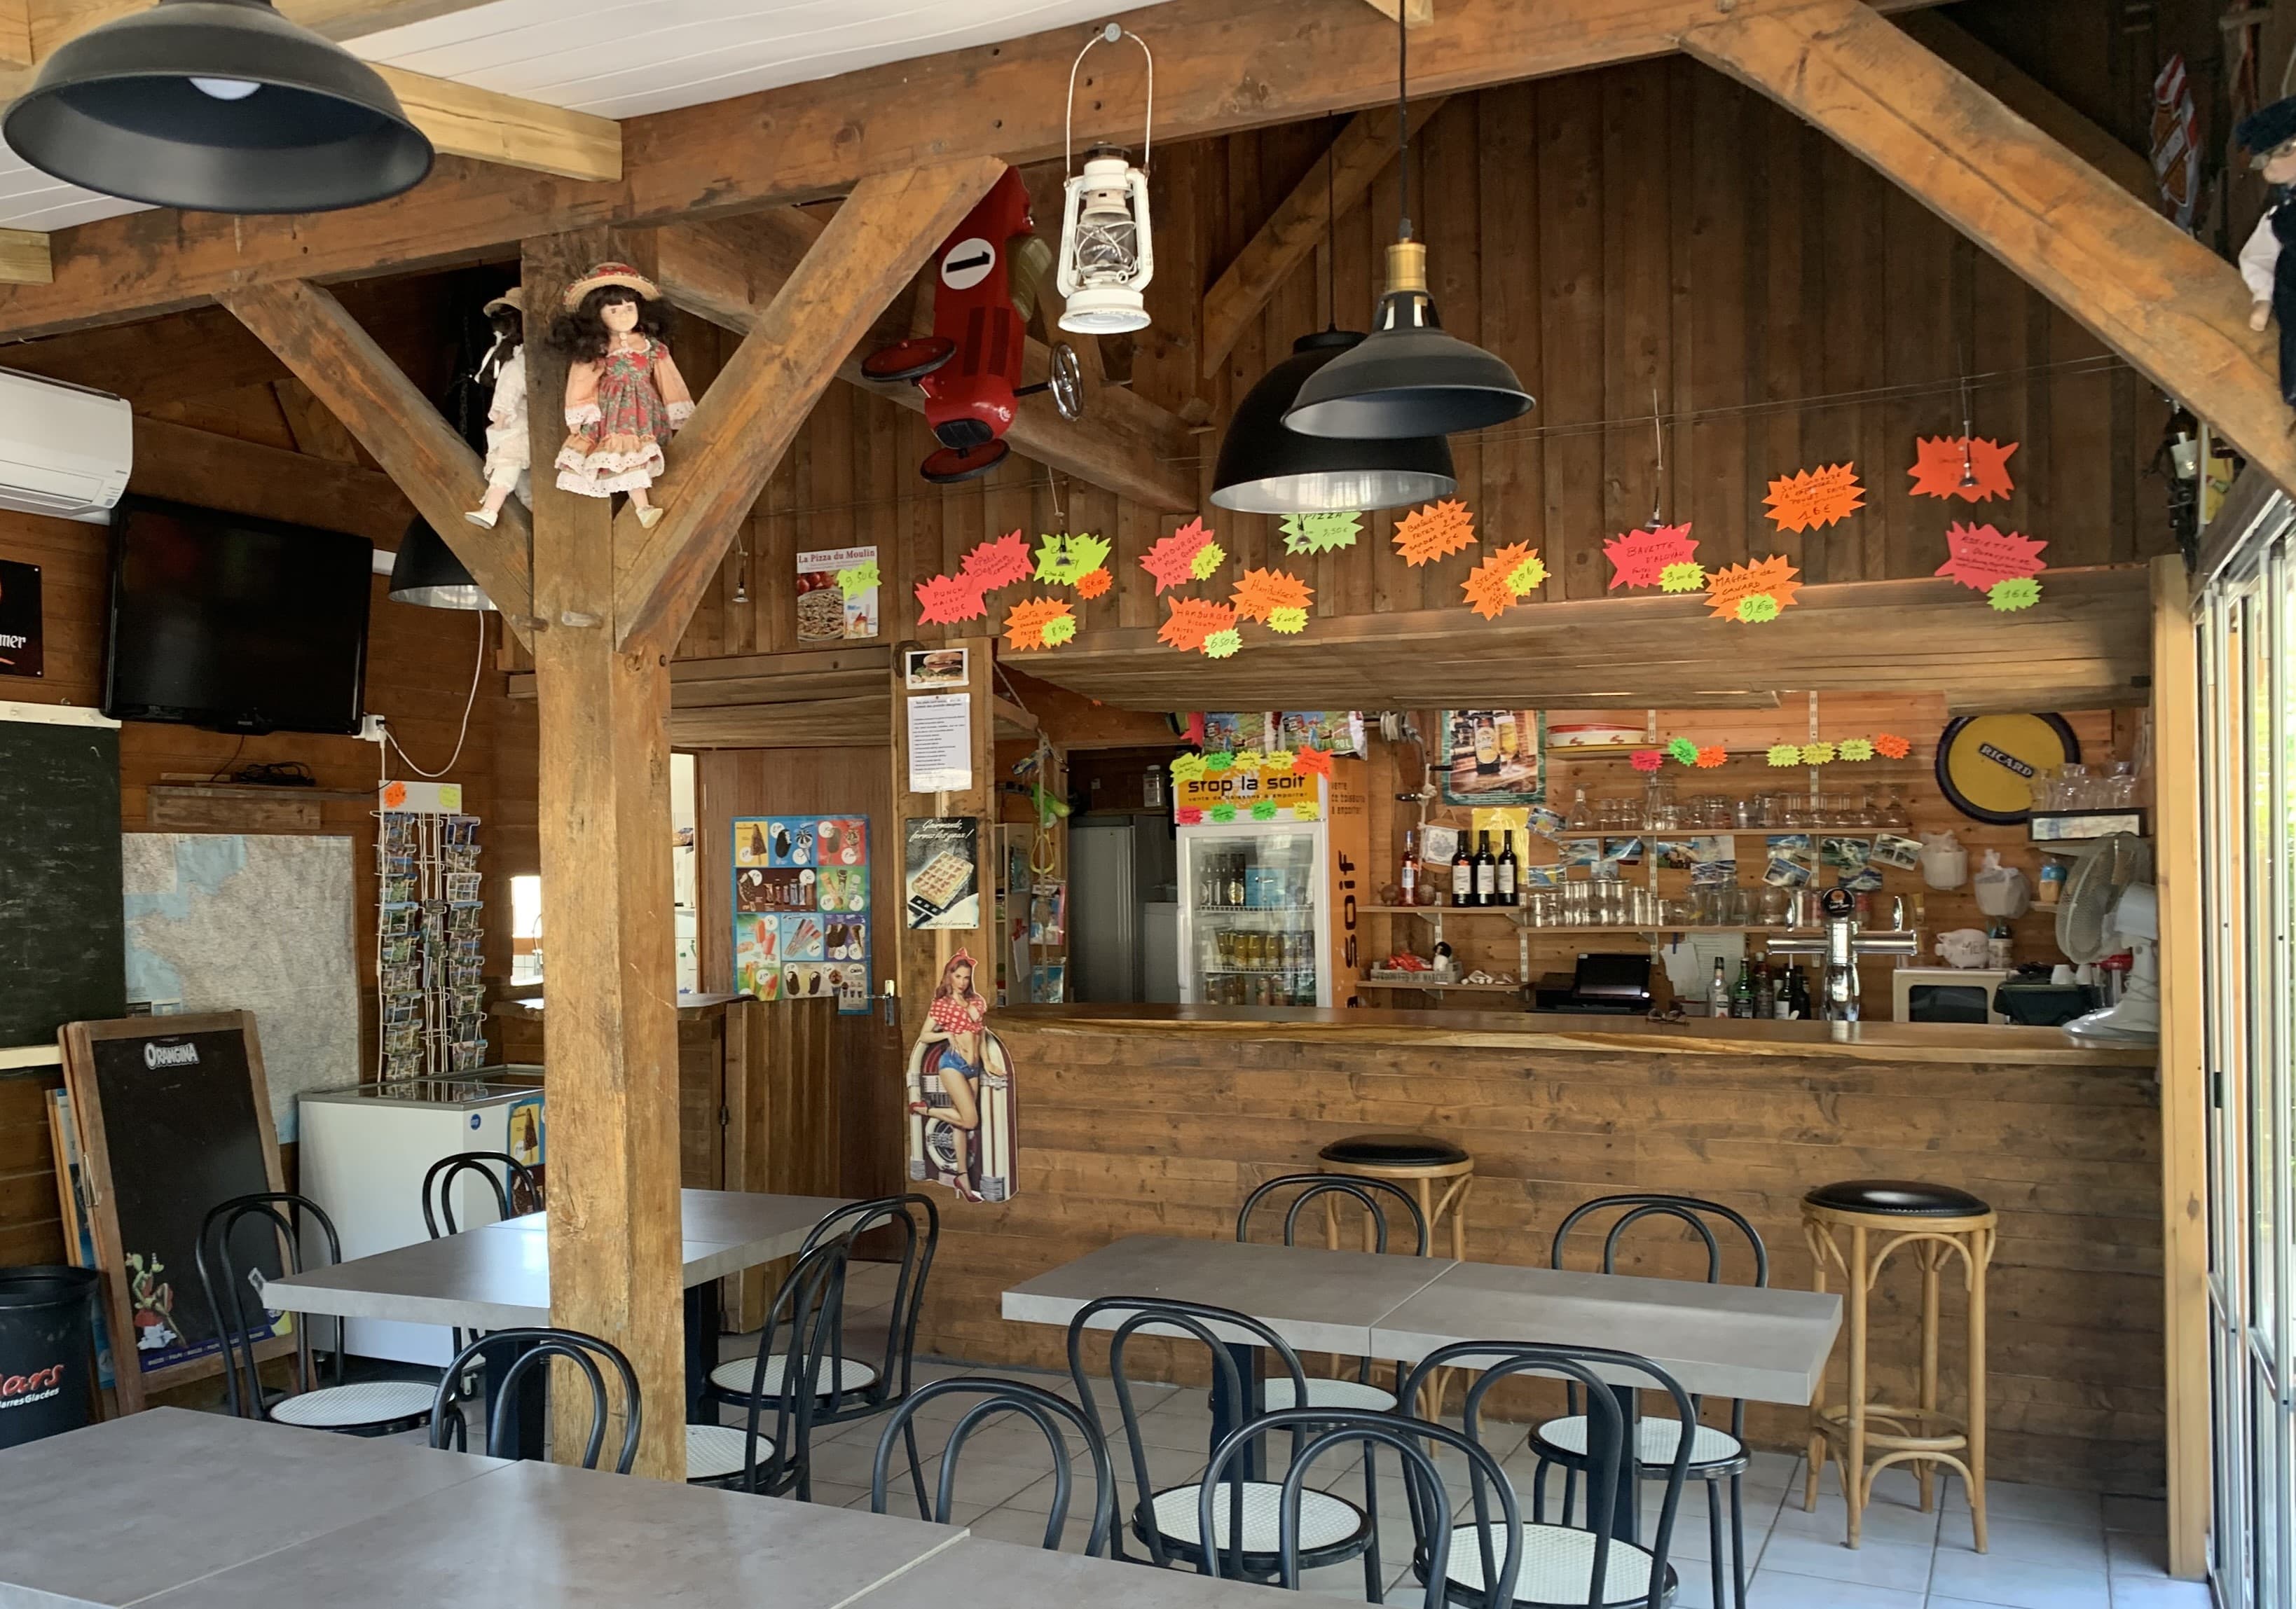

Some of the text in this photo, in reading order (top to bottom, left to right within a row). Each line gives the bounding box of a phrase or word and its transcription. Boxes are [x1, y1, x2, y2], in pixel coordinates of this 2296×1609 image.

[947, 251, 991, 273] 1
[1304, 512, 1342, 520] PIZZA
[811, 554, 832, 562] Pizza
[834, 551, 844, 560] du
[846, 549, 875, 559] Moulin
[1626, 541, 1675, 557] BAVETTE
[1177, 609, 1234, 621] HAMBURGER
[1980, 745, 2032, 776] RICARD
[1188, 779, 1232, 796] stop
[1242, 775, 1258, 790] la
[144, 1042, 200, 1070] ORANGINA
[0, 1397, 25, 1409] arres
